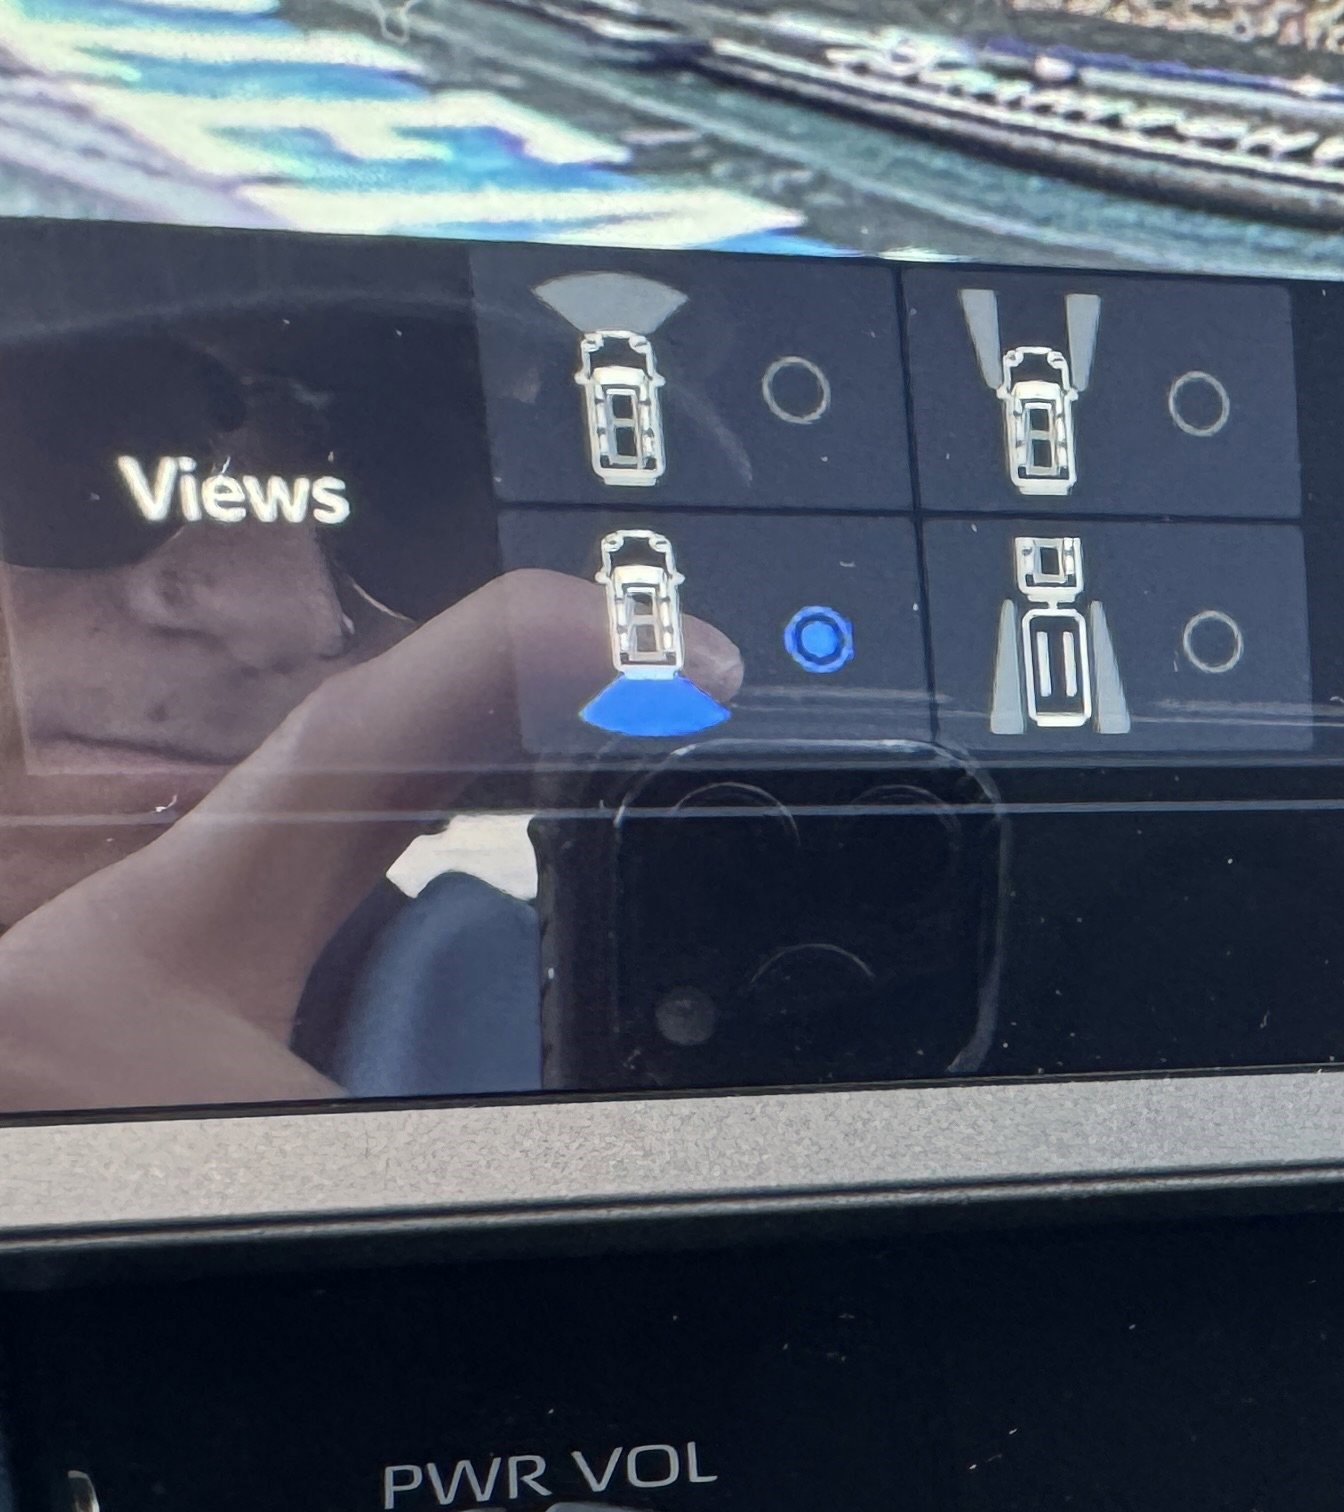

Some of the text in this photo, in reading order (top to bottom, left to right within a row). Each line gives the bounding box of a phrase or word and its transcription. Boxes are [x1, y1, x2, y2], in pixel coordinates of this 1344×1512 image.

[118, 456, 349, 524] Views
[384, 1442, 718, 1509] PWR VOL
